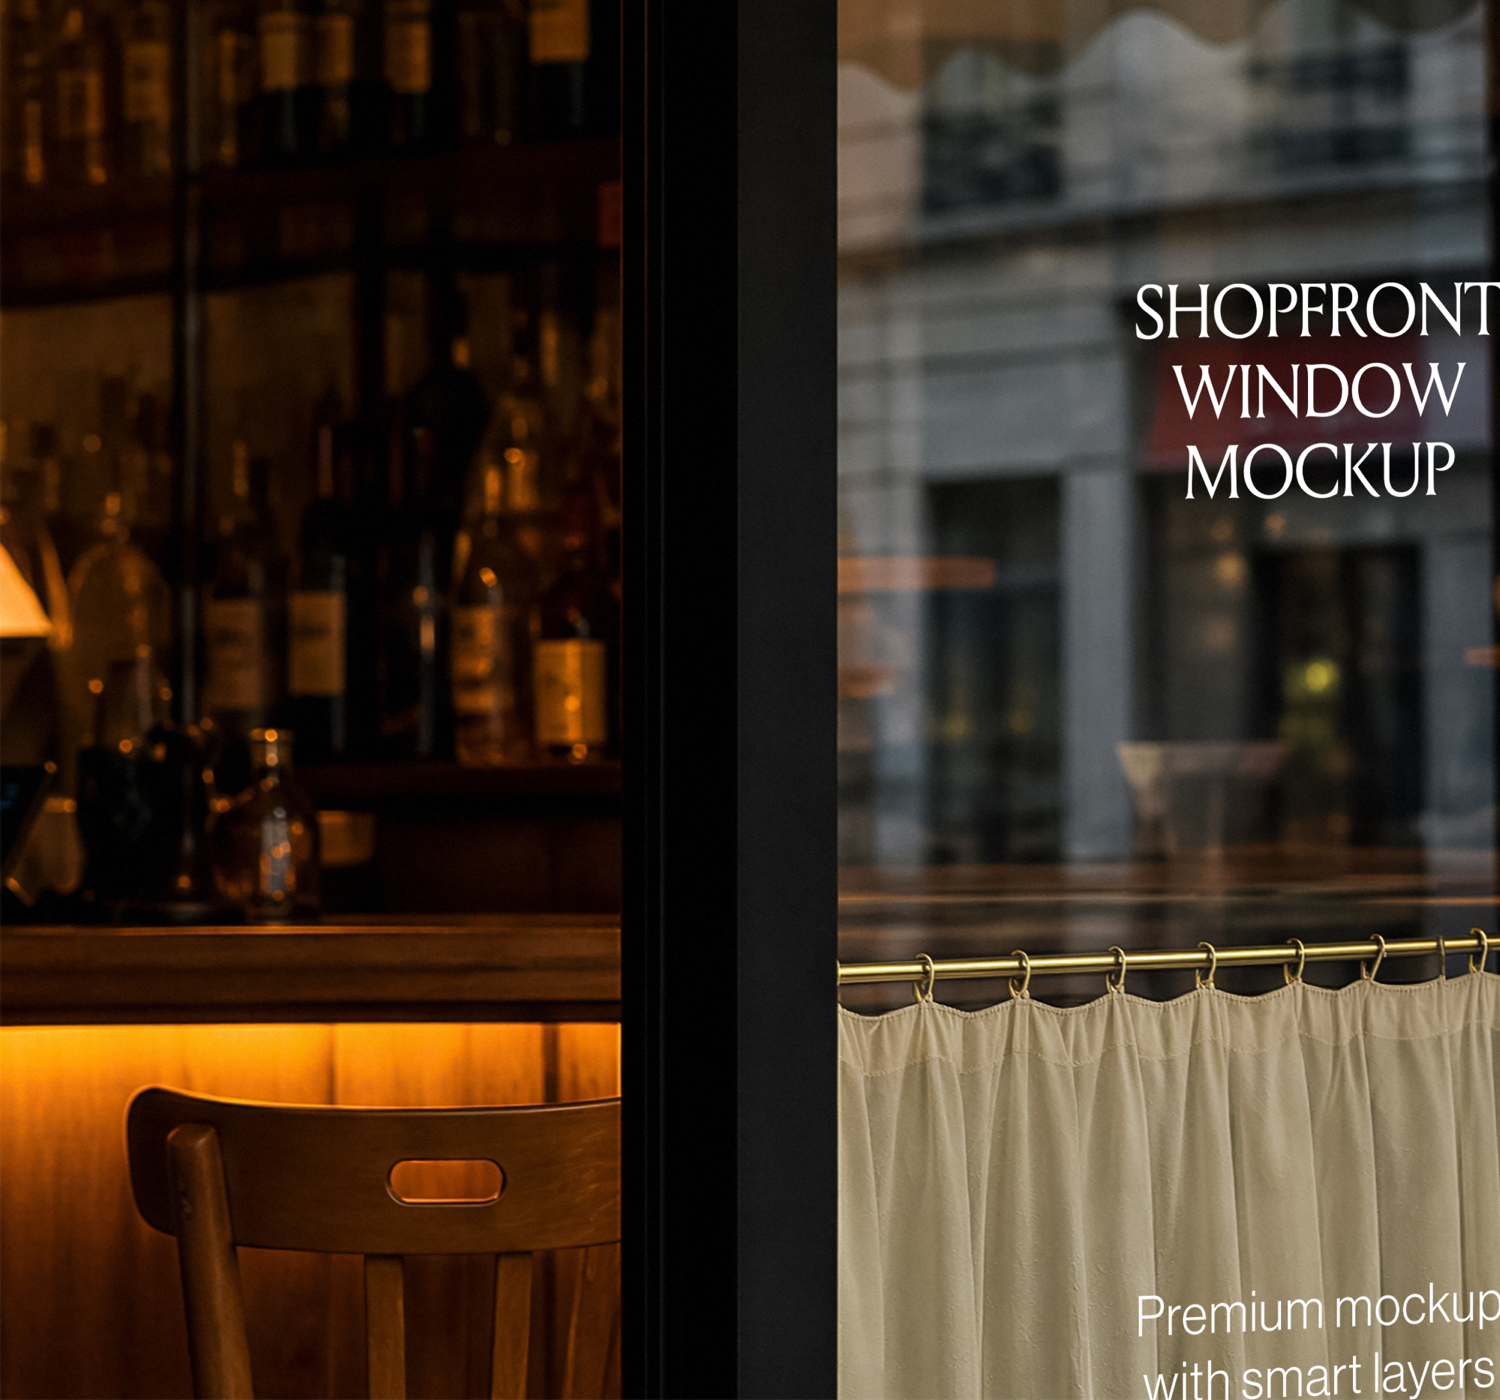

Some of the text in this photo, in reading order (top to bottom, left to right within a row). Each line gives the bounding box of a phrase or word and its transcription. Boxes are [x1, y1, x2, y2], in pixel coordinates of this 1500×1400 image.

[1172, 362, 1467, 419] WINDOW
[1185, 442, 1455, 500] MOCKUP
[1137, 1290, 1323, 1338] Premium
[1142, 1351, 1495, 1400] with smart layers
